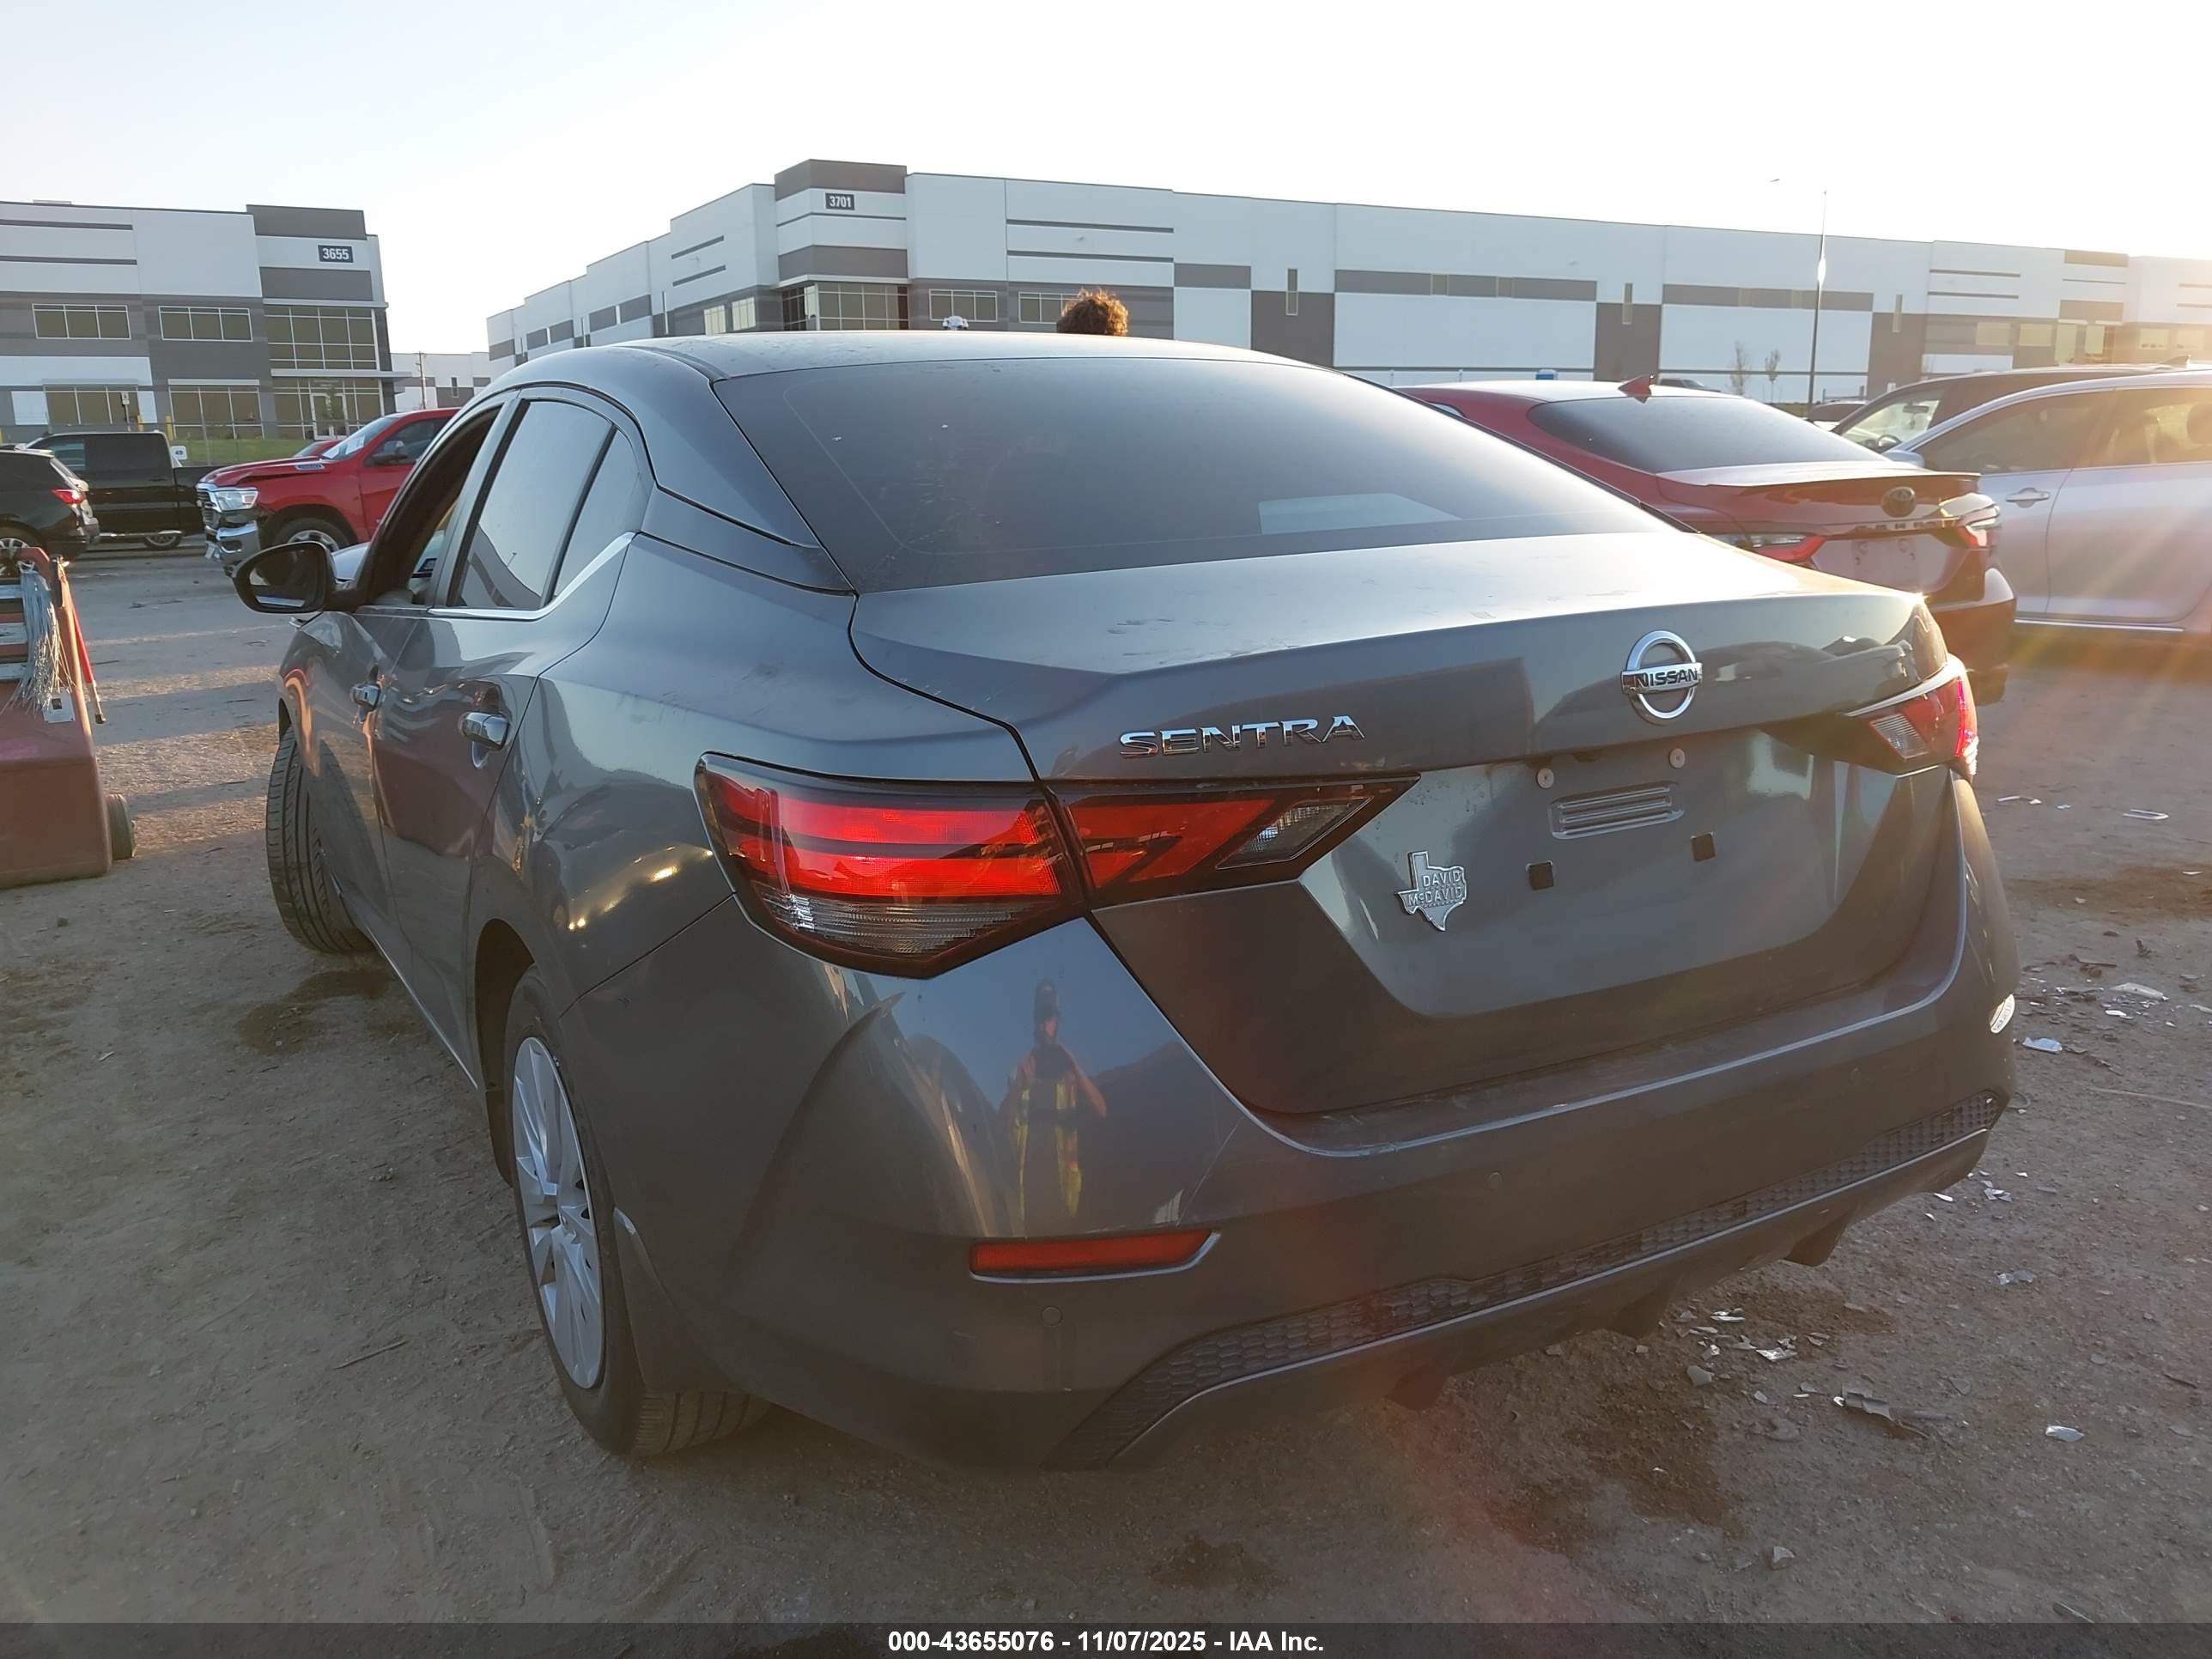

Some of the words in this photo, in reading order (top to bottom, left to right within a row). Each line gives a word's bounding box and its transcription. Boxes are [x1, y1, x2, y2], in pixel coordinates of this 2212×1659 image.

[829, 196, 851, 208] 3701
[322, 247, 349, 260] 3655
[1635, 668, 1698, 688] NISSAN
[1120, 714, 1365, 757] SENTRA
[1423, 870, 1462, 887] DAVID
